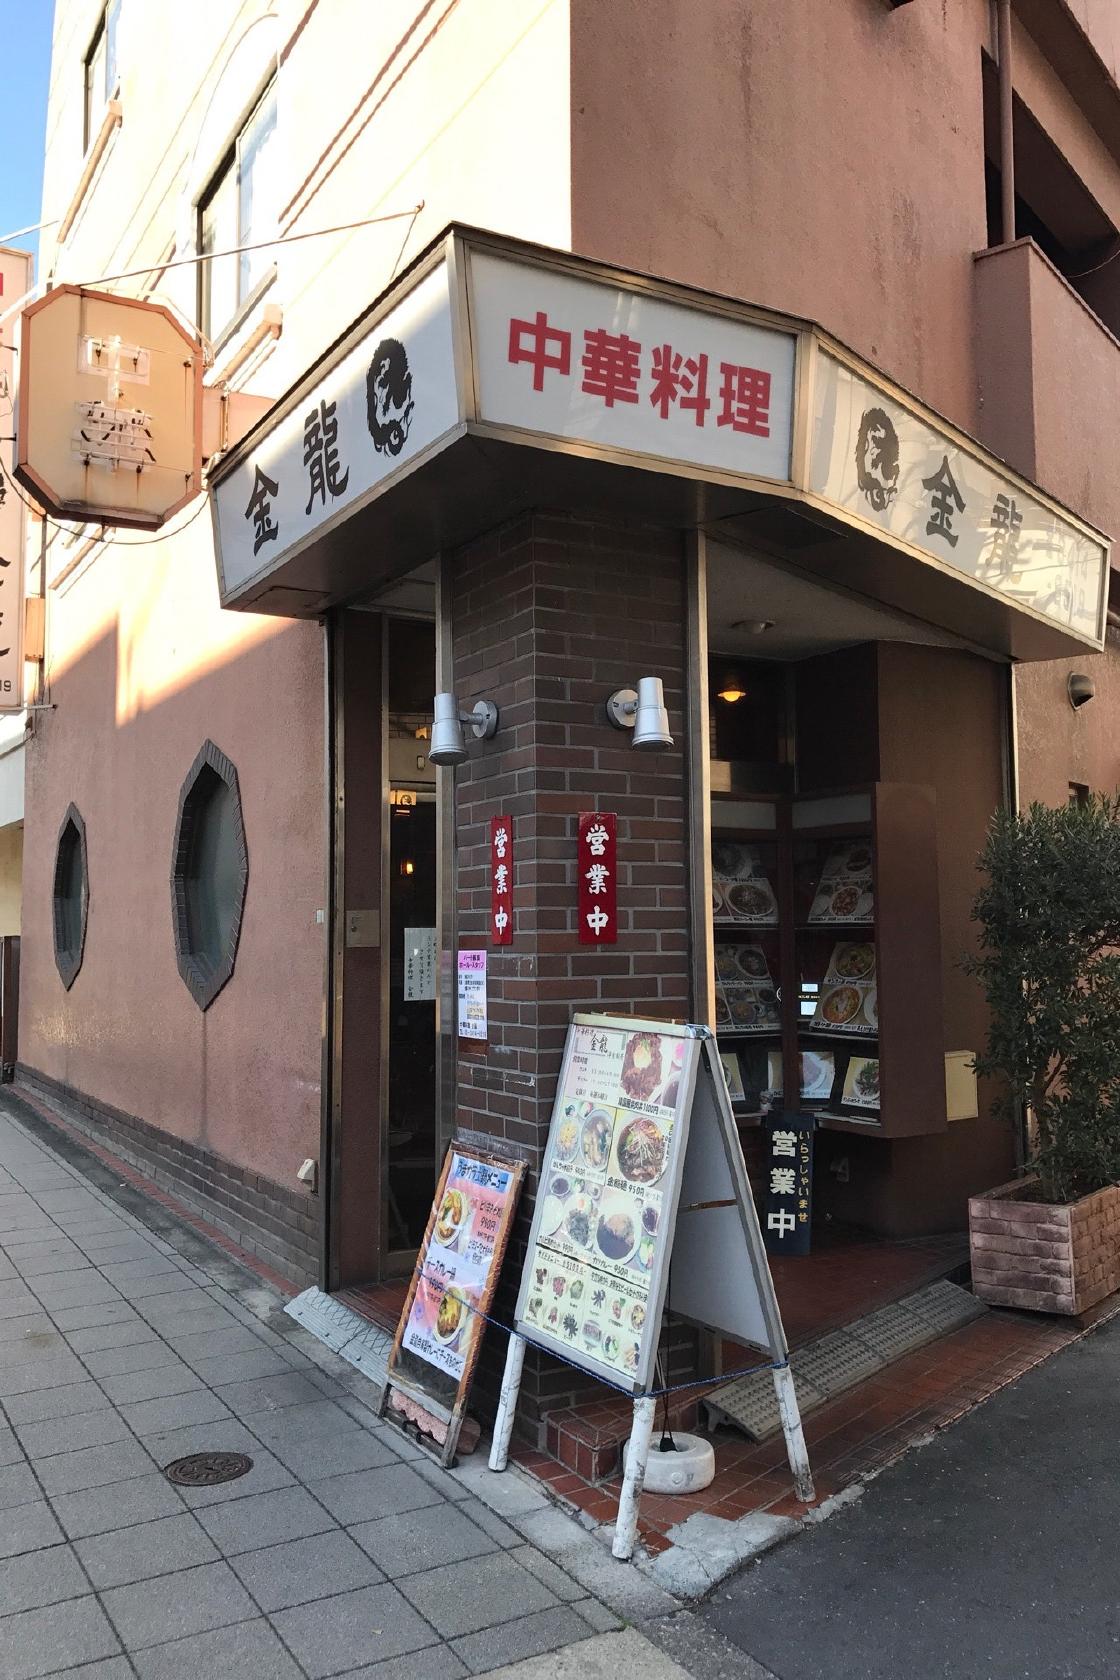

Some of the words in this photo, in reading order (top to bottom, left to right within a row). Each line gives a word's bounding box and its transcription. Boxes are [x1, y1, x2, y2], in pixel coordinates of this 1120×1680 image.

[507, 312, 771, 438] 中華料理
[245, 399, 350, 556] 金龍
[494, 827, 509, 936] 営業中
[585, 823, 610, 937] 営業中
[628, 1185, 645, 1197] 950円
[767, 1130, 798, 1239] 営業中
[798, 1131, 810, 1223] いらっしゃいませ
